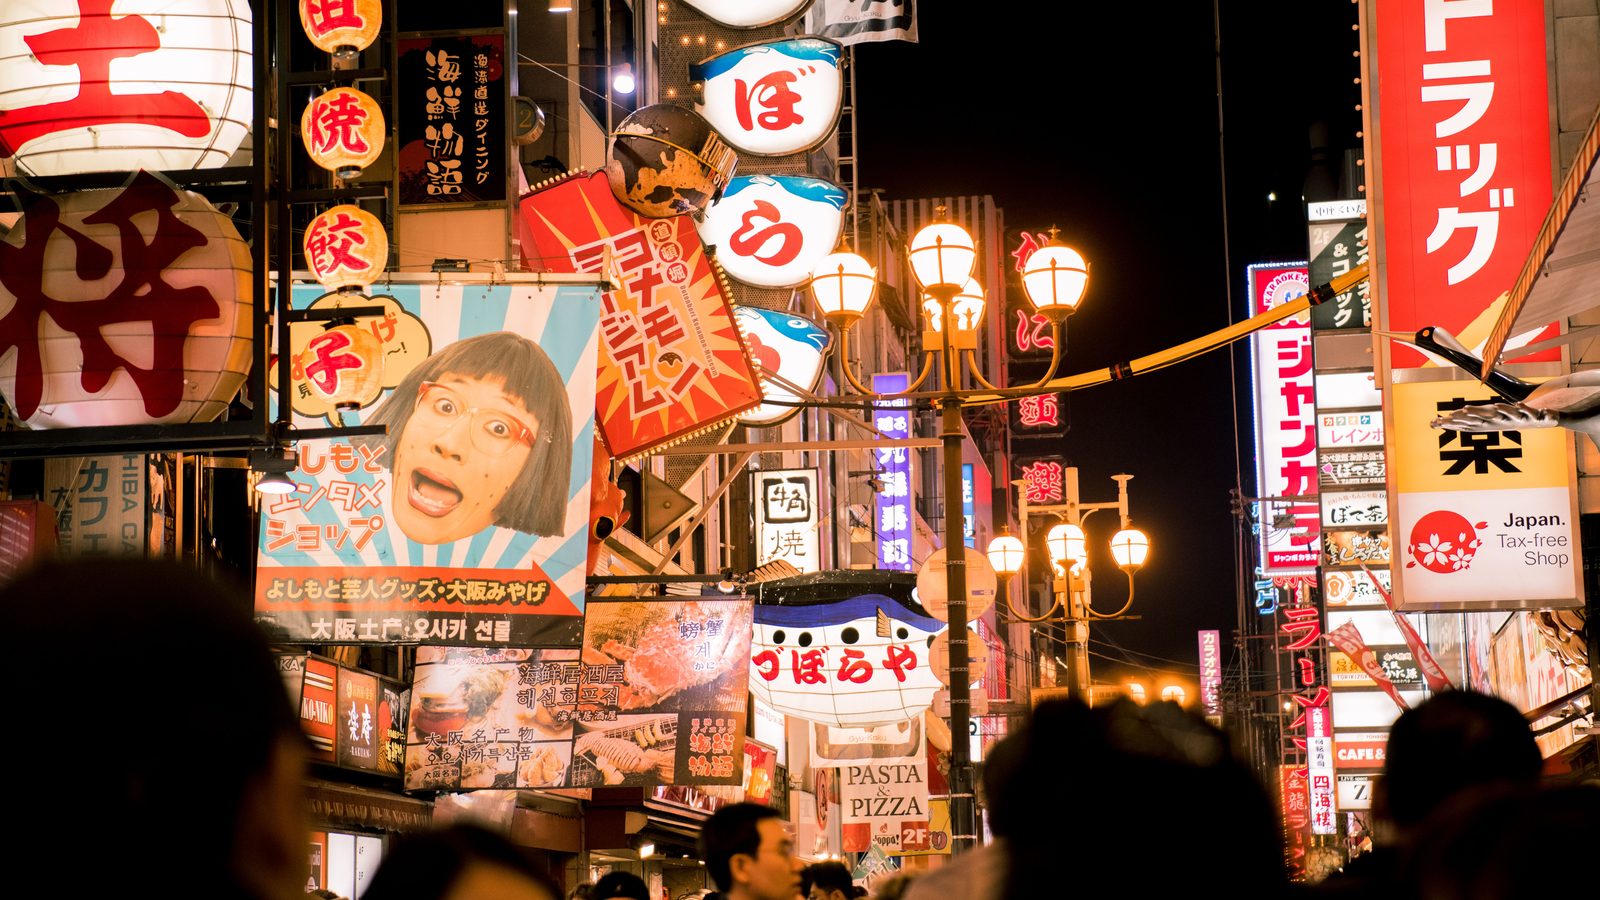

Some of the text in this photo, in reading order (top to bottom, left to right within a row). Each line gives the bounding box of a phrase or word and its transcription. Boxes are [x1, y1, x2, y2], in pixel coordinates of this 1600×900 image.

[424, 49, 464, 195] 海鮮物語
[650, 219, 690, 284] 道頓堀
[296, 444, 387, 475] しもと
[1503, 512, 1566, 531] Japan.
[265, 514, 385, 553] ショップ
[1496, 532, 1568, 549] Tax-free
[1524, 550, 1569, 568] Shop
[266, 578, 548, 604] よしもと芸人グッズ・大阪みやげ
[516, 663, 625, 687] 海鮮居酒屋
[751, 644, 918, 685] づぼらや
[516, 686, 620, 710] 해선호프집
[1337, 748, 1386, 760] CAFE &
[847, 764, 924, 786] PASTA
[877, 785, 890, 797] &
[850, 796, 923, 818] PIZZA
[902, 828, 927, 845] 2F
